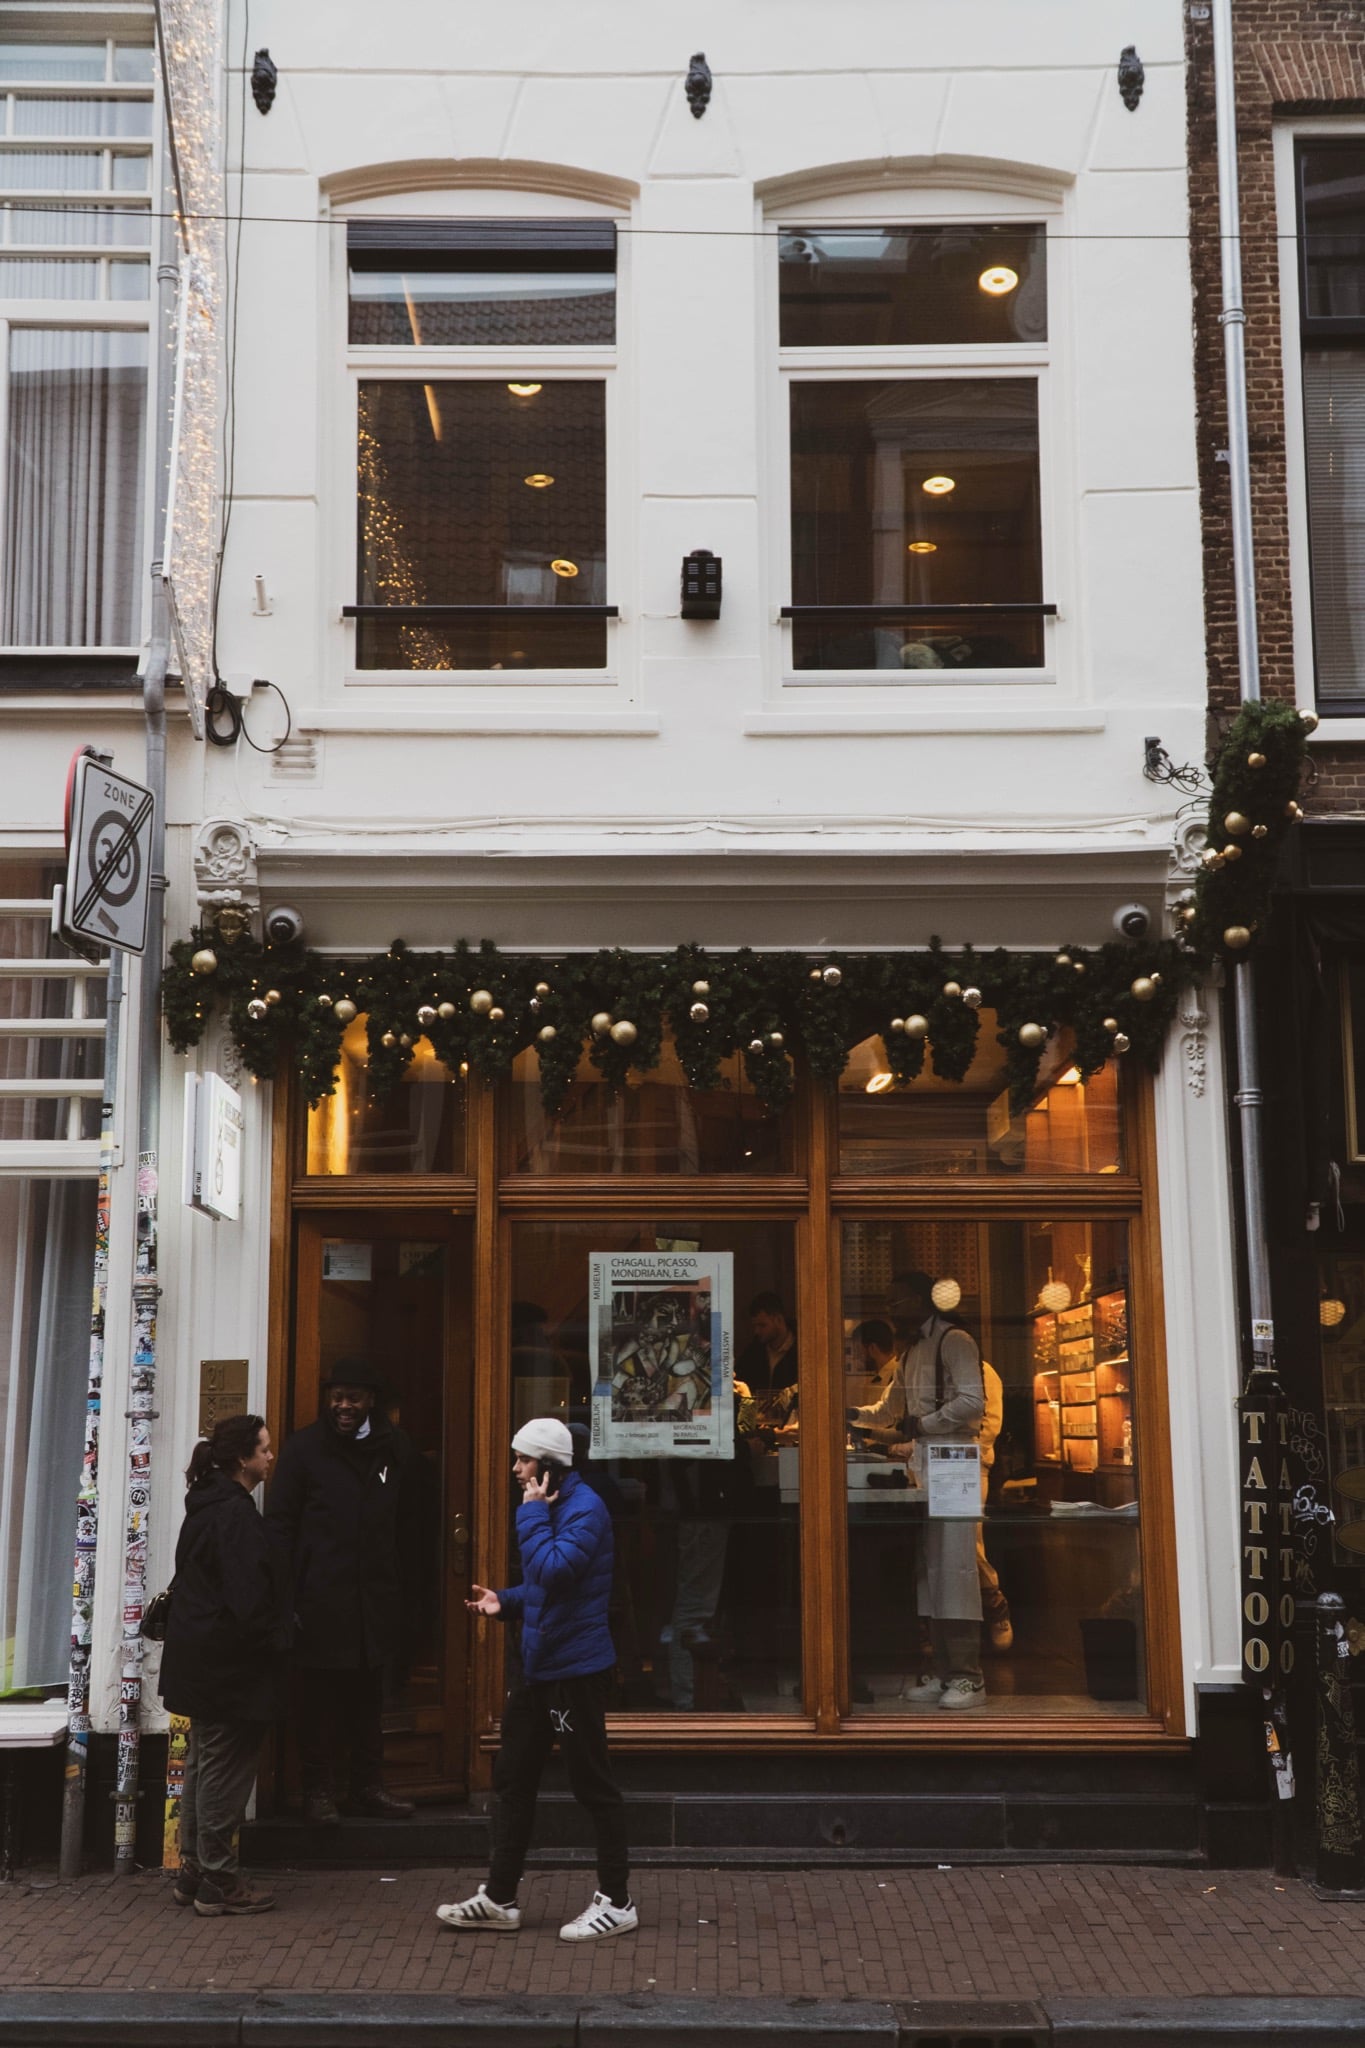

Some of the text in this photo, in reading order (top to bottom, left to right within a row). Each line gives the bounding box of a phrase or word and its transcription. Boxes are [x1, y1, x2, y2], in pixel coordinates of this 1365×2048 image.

[104, 782, 135, 810] ZONE
[611, 1258, 698, 1268] CHAGALL, PICASSO,
[611, 1268, 691, 1279] MONDRIAAN, E.A.
[593, 1263, 601, 1300] MUSEUM
[722, 1331, 730, 1378] AMSTERDAM
[593, 1403, 601, 1447] STEDELIJK
[1242, 1411, 1271, 1673] TATTOO
[1276, 1412, 1295, 1675] TATTOO
[121, 1681, 140, 1691] FCK
[121, 1690, 140, 1700] AFD
